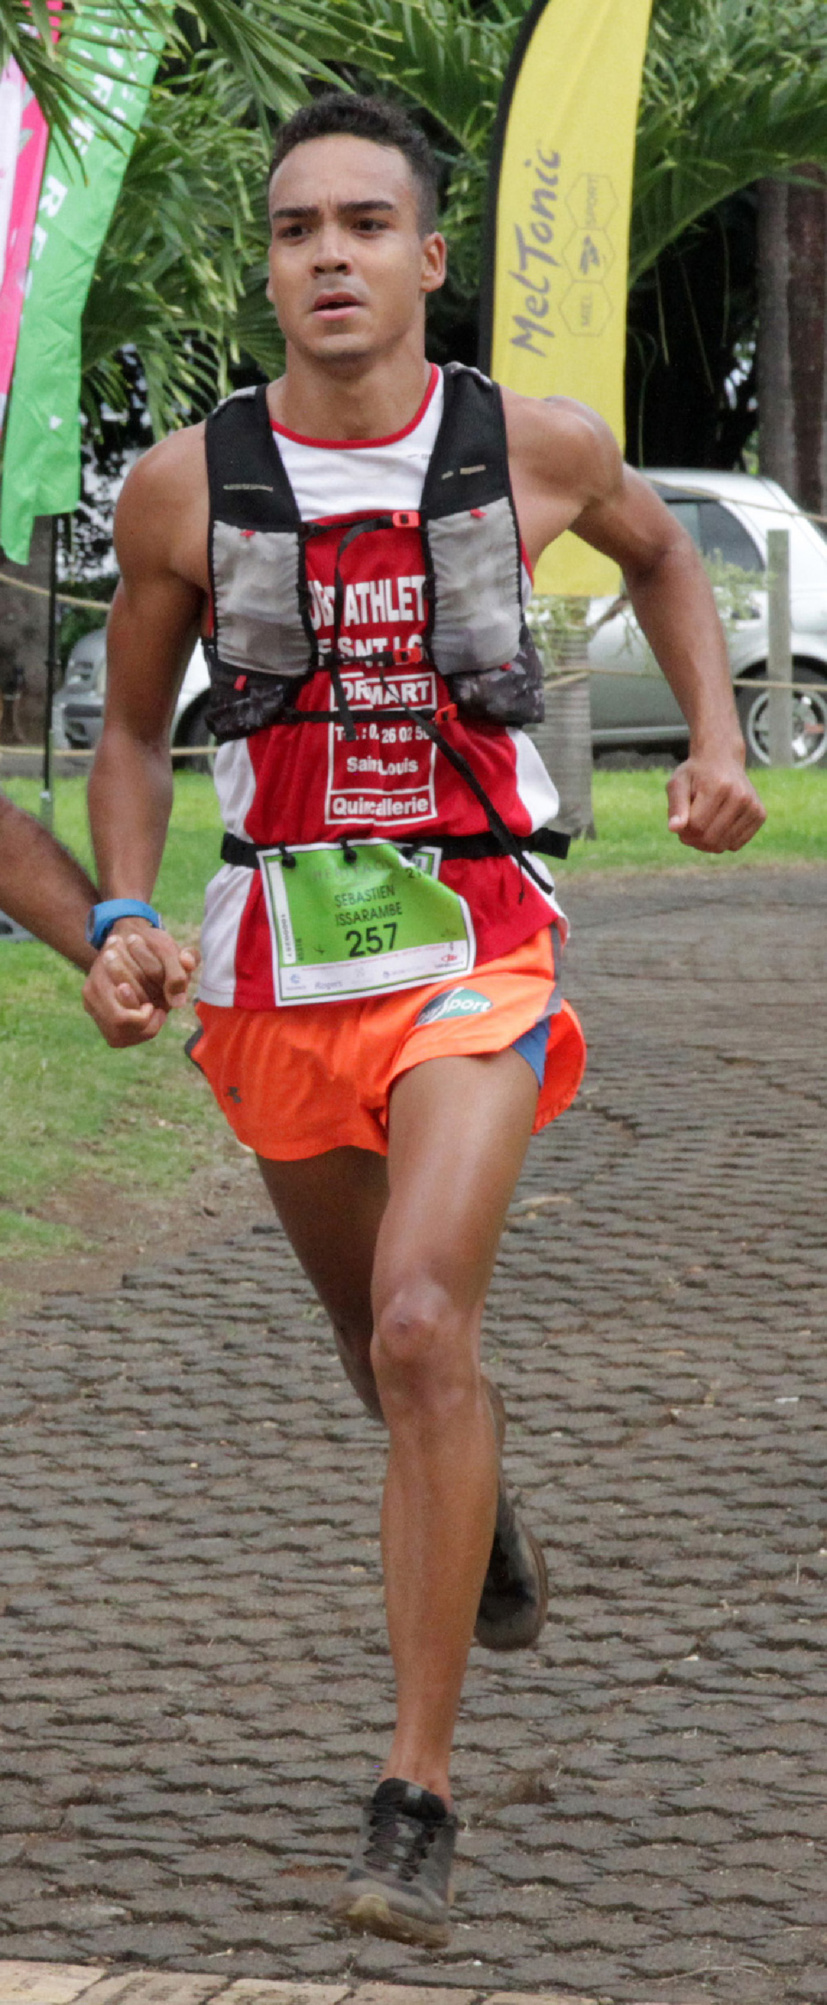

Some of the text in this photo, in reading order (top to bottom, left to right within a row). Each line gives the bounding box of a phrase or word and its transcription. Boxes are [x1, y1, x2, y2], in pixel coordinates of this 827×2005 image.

[509, 140, 561, 358] MelTonic
[381, 726, 397, 744] 26
[334, 884, 396, 908] SEBASTIEN
[335, 901, 403, 926] ISSARAMBE
[345, 922, 398, 957] 257
